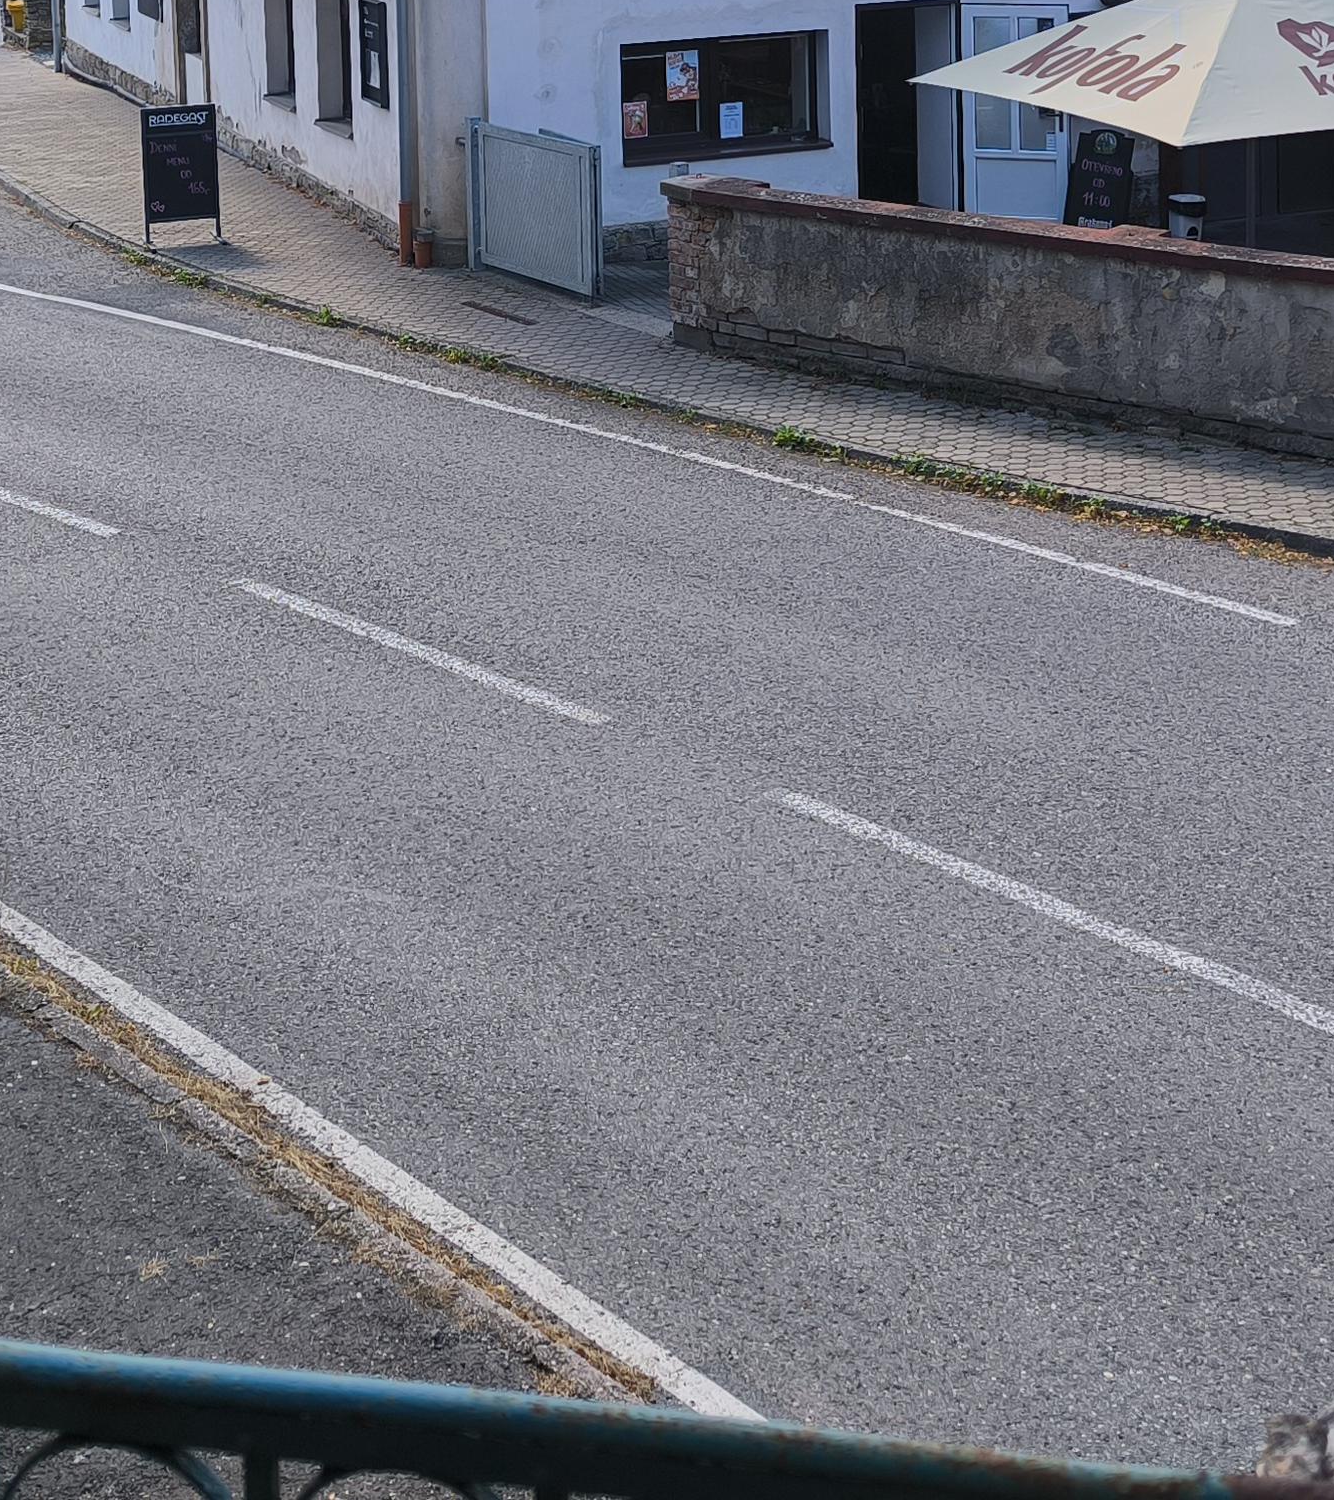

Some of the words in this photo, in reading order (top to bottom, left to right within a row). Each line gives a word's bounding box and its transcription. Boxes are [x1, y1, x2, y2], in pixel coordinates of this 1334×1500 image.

[1003, 24, 1187, 102] kofola
[148, 110, 209, 127] RADEGAST
[1092, 178, 1105, 189] OD
[1083, 191, 1111, 208] 11:00
